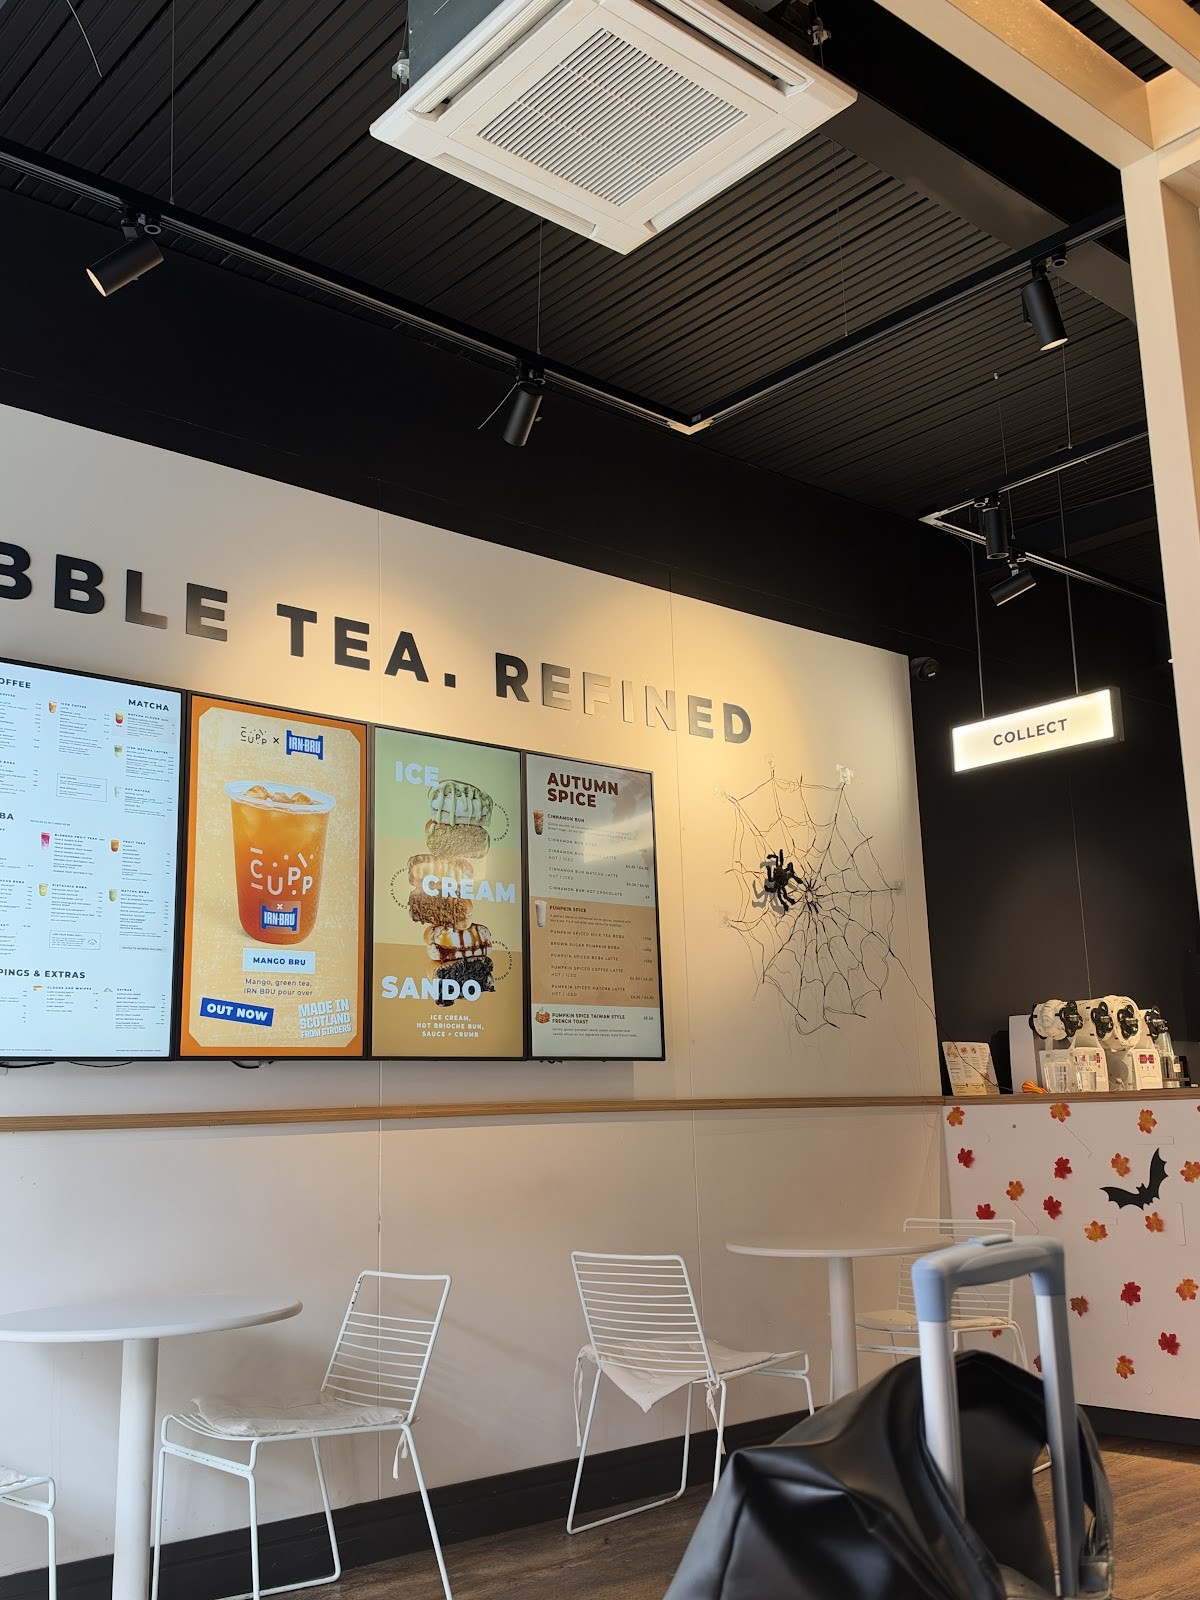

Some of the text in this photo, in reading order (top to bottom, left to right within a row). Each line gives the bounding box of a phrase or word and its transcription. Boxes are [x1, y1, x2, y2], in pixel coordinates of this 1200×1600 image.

[276, 603, 456, 689] TEA.
[495, 652, 752, 745] REFINED
[128, 698, 170, 712] MATCHA
[993, 718, 1068, 746] COLLECT
[395, 761, 439, 787] ICE
[547, 772, 619, 796] AUTUMN
[547, 788, 597, 808] SPICE
[547, 813, 574, 821] CINNAMON
[548, 848, 574, 856] CINNAMON
[250, 850, 314, 896] CUPP
[422, 874, 516, 904] CREAM
[252, 956, 306, 966] MANGO BRU
[33, 969, 41, 977] &
[45, 970, 86, 979] EXTRAS
[245, 978, 273, 986] Mango,
[299, 980, 312, 988] tea,
[381, 976, 481, 1001] SANDO
[206, 1003, 268, 1021] OUT NOW
[299, 998, 349, 1017] MADE IN
[301, 1012, 351, 1029] SCOTLAND
[301, 1024, 352, 1039] FROM GIRDERS
